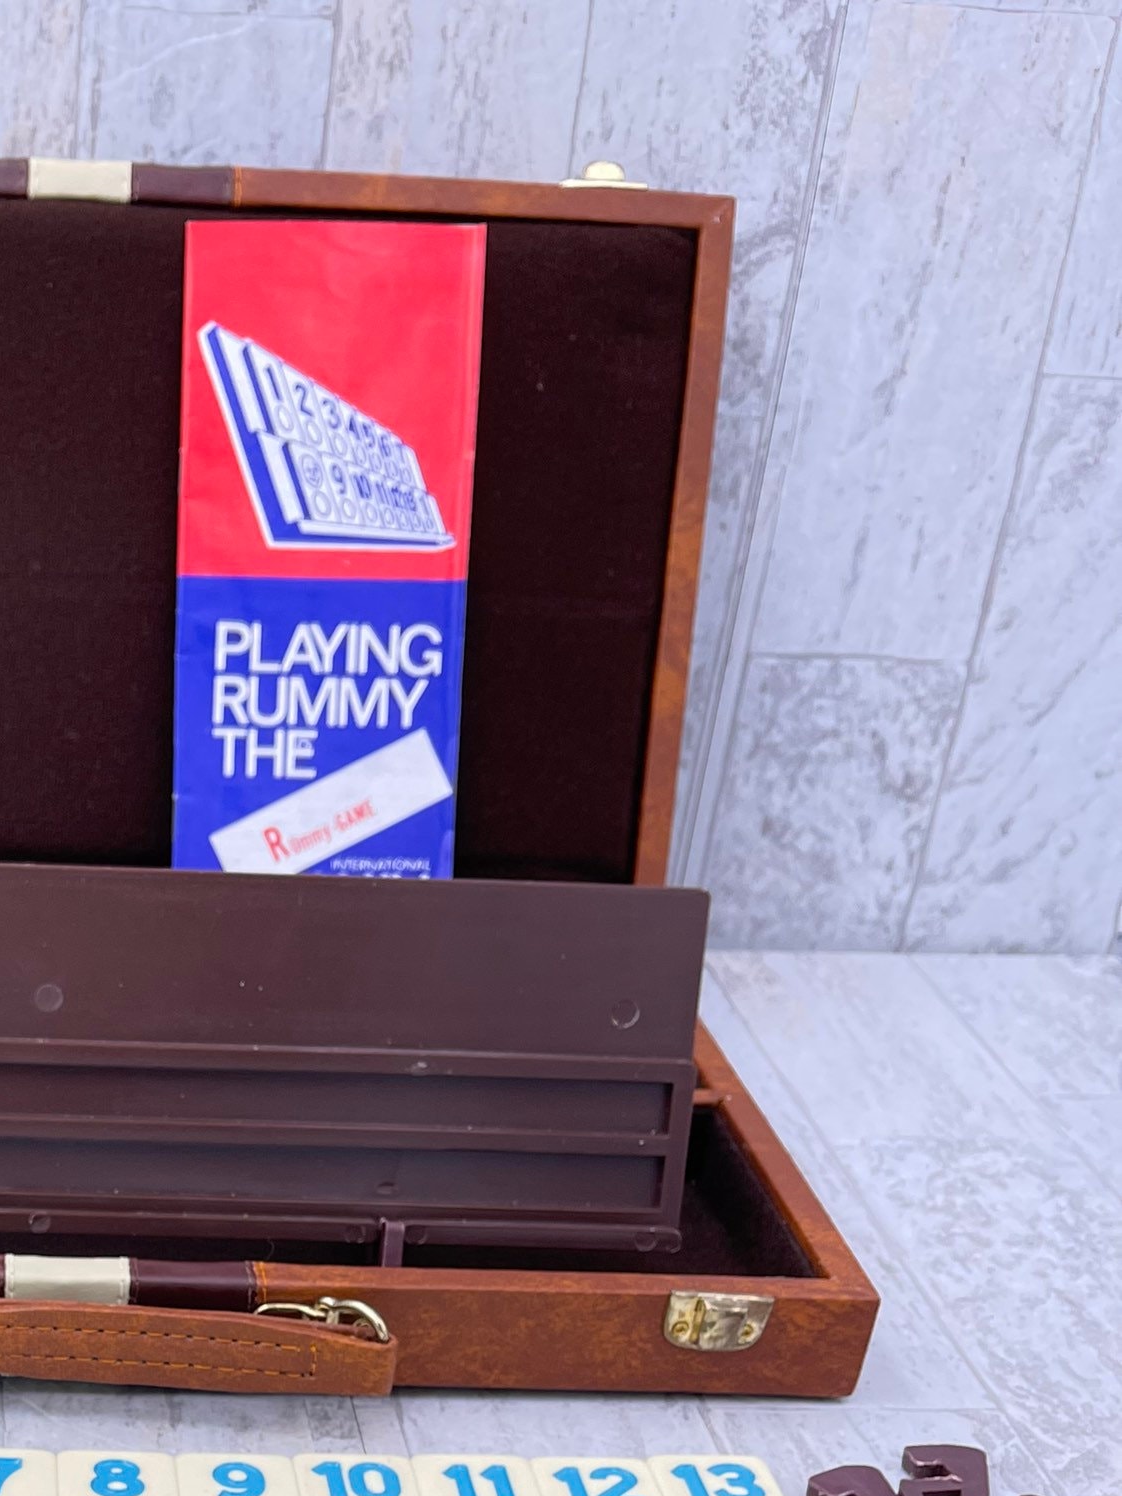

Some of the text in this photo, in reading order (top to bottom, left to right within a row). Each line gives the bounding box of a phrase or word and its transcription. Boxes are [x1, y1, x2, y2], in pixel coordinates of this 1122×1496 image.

[266, 366, 281, 401] 1
[294, 383, 314, 417] 2
[322, 397, 341, 430] 3
[331, 463, 347, 495] 9
[214, 618, 444, 678] PLAYING
[211, 674, 430, 730] RUMMY
[211, 727, 319, 780] THE
[330, 857, 431, 872] INTERNATIONAL
